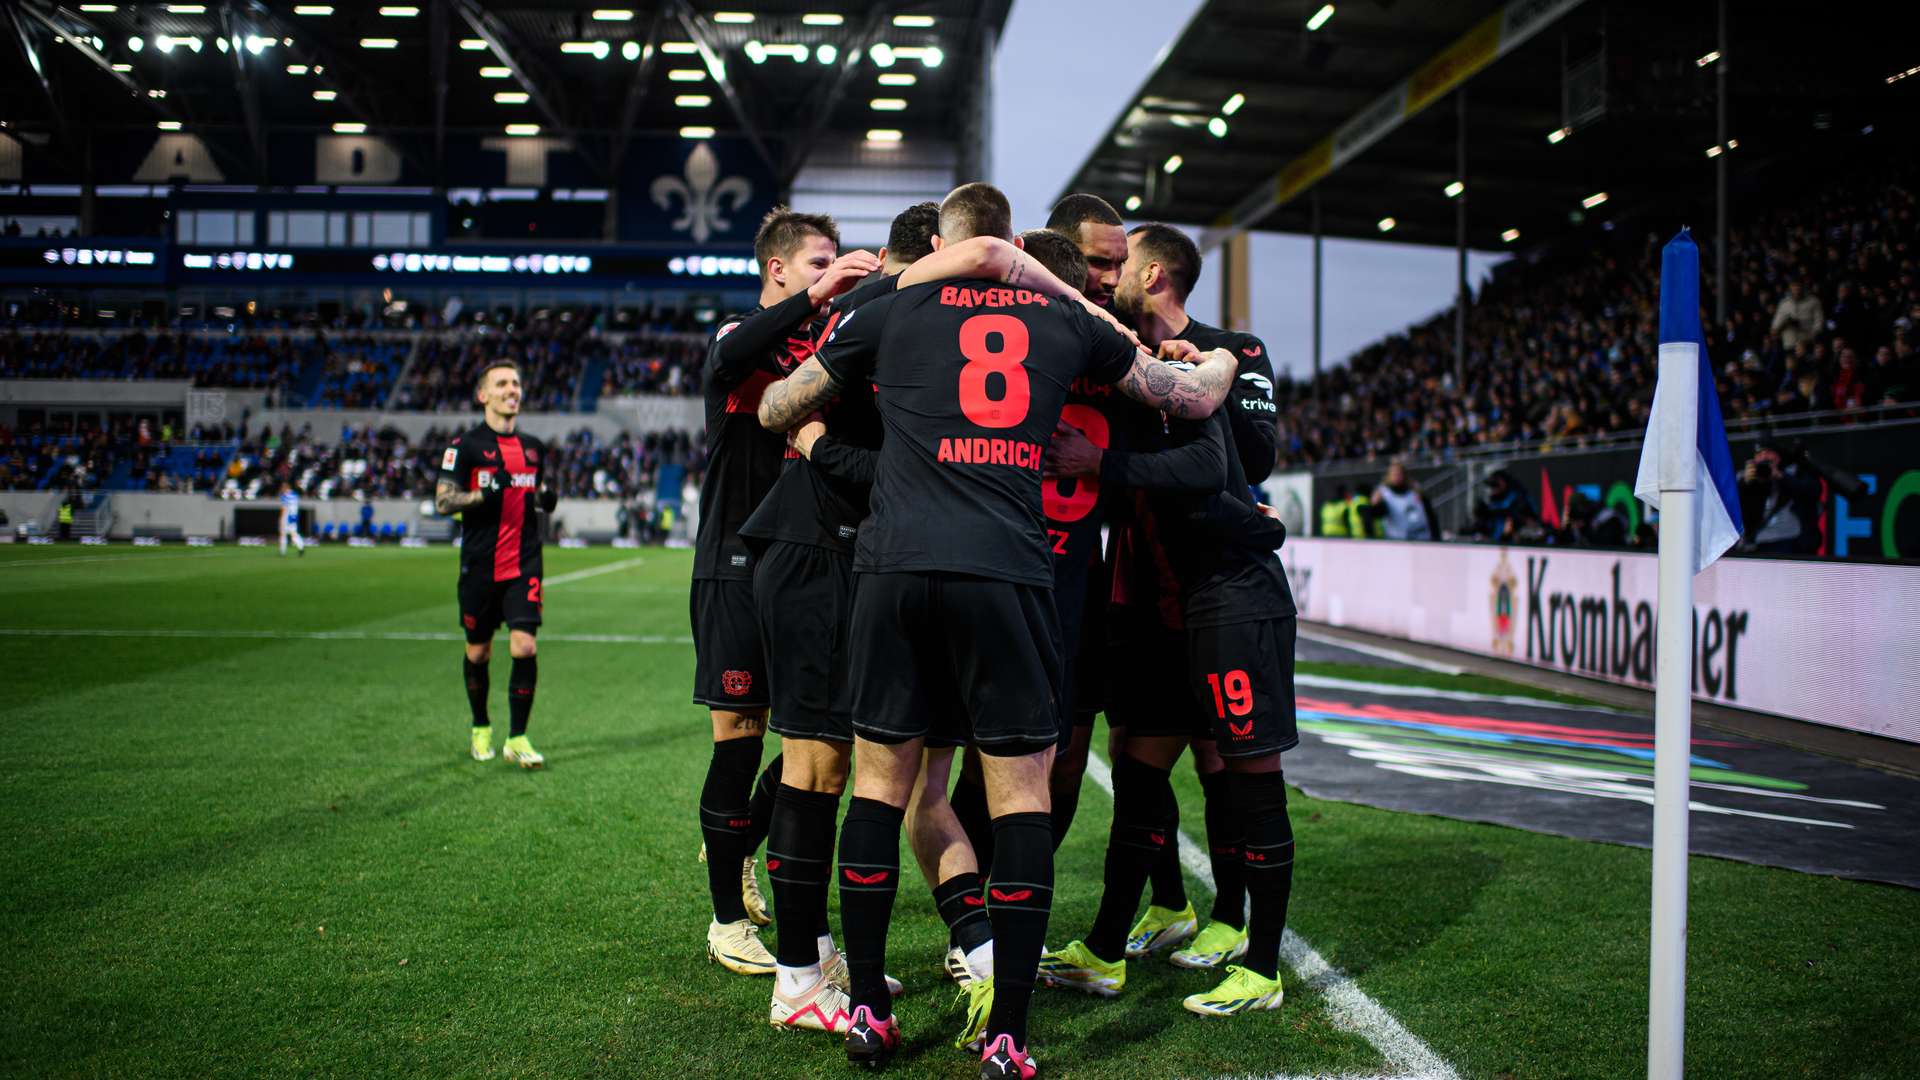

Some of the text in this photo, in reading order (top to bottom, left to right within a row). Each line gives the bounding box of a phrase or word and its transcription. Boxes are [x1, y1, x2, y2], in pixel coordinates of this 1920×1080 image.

[940, 285, 1014, 308] BAYER
[959, 313, 1031, 429] 8
[1241, 398, 1276, 412] trive
[937, 437, 1042, 470] ANDRICH
[527, 577, 543, 603] 2
[1526, 556, 1750, 700] Krombaer
[1207, 669, 1253, 719] 19
